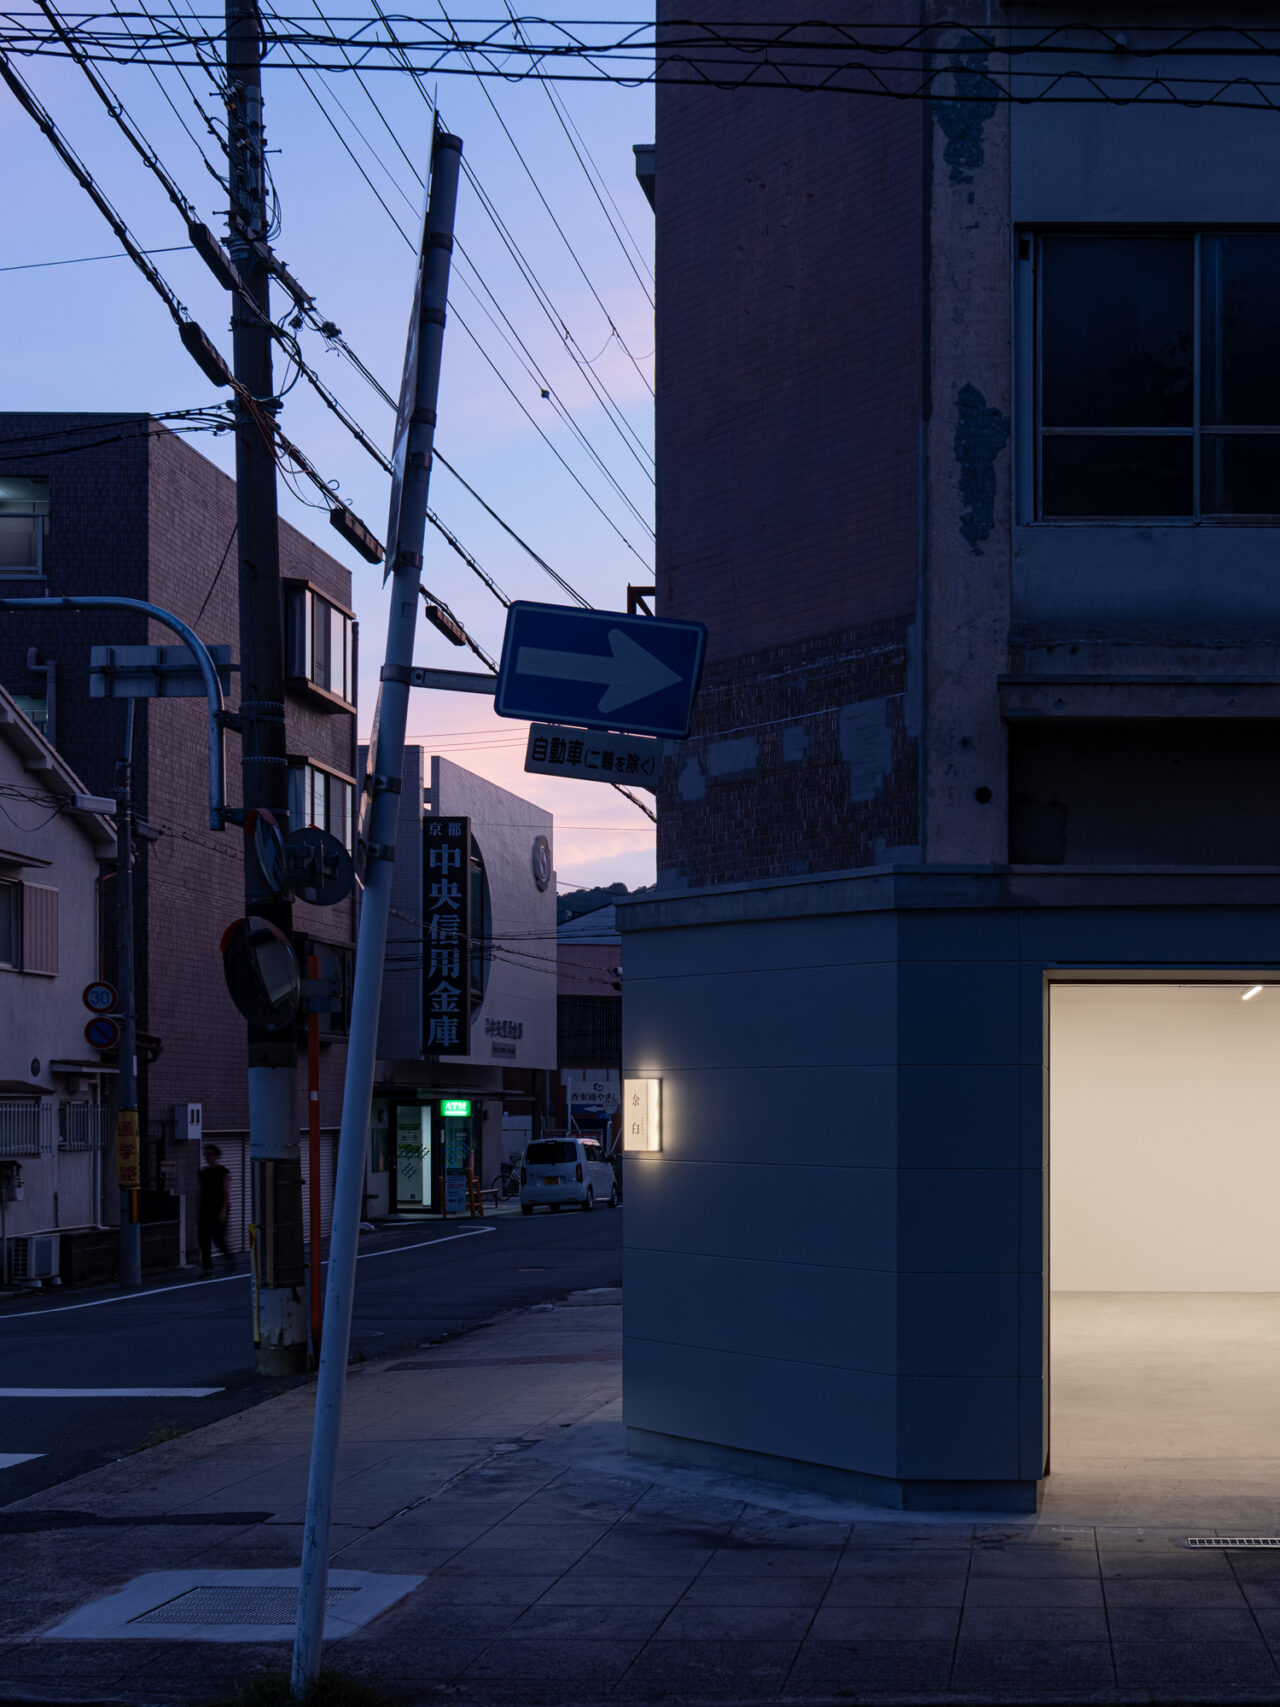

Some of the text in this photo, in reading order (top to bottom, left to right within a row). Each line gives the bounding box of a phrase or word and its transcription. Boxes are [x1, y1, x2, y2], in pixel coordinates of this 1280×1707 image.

[531, 735, 655, 776] 自動車(二輪を除く)
[427, 821, 462, 838] 京都
[427, 843, 462, 1048] 中央信用金庫
[91, 990, 110, 1005] 30
[445, 1102, 466, 1110] ATM
[117, 1121, 137, 1181] 通学路
